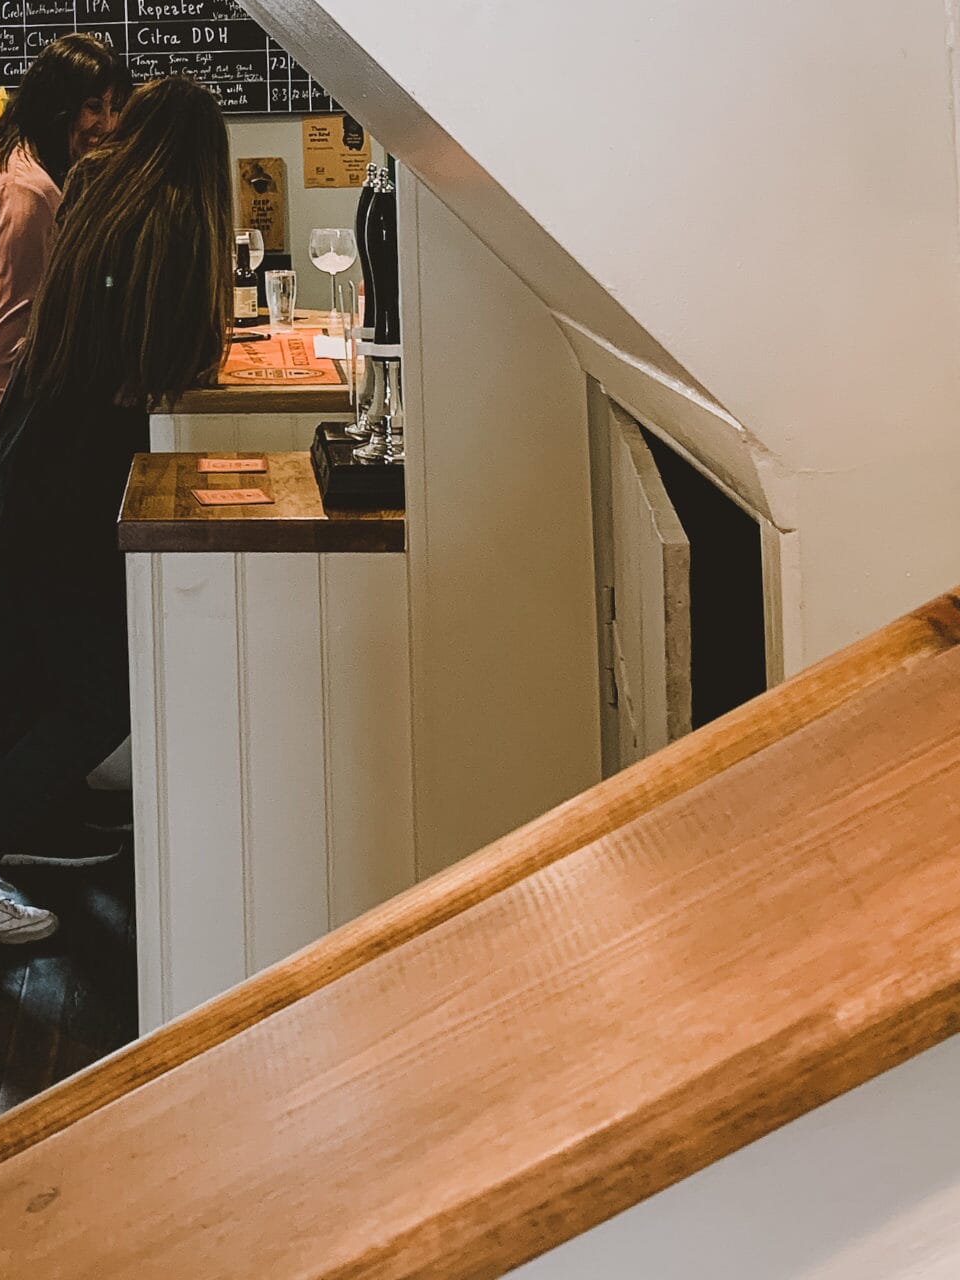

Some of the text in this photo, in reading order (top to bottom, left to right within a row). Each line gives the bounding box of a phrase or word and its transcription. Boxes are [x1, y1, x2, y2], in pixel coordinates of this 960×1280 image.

[86, 0, 110, 13] IPA
[137, 0, 204, 20] Repeater
[137, 26, 228, 45] Citra DDH
[270, 56, 287, 70] 7.2
[272, 88, 288, 101] 8.3
